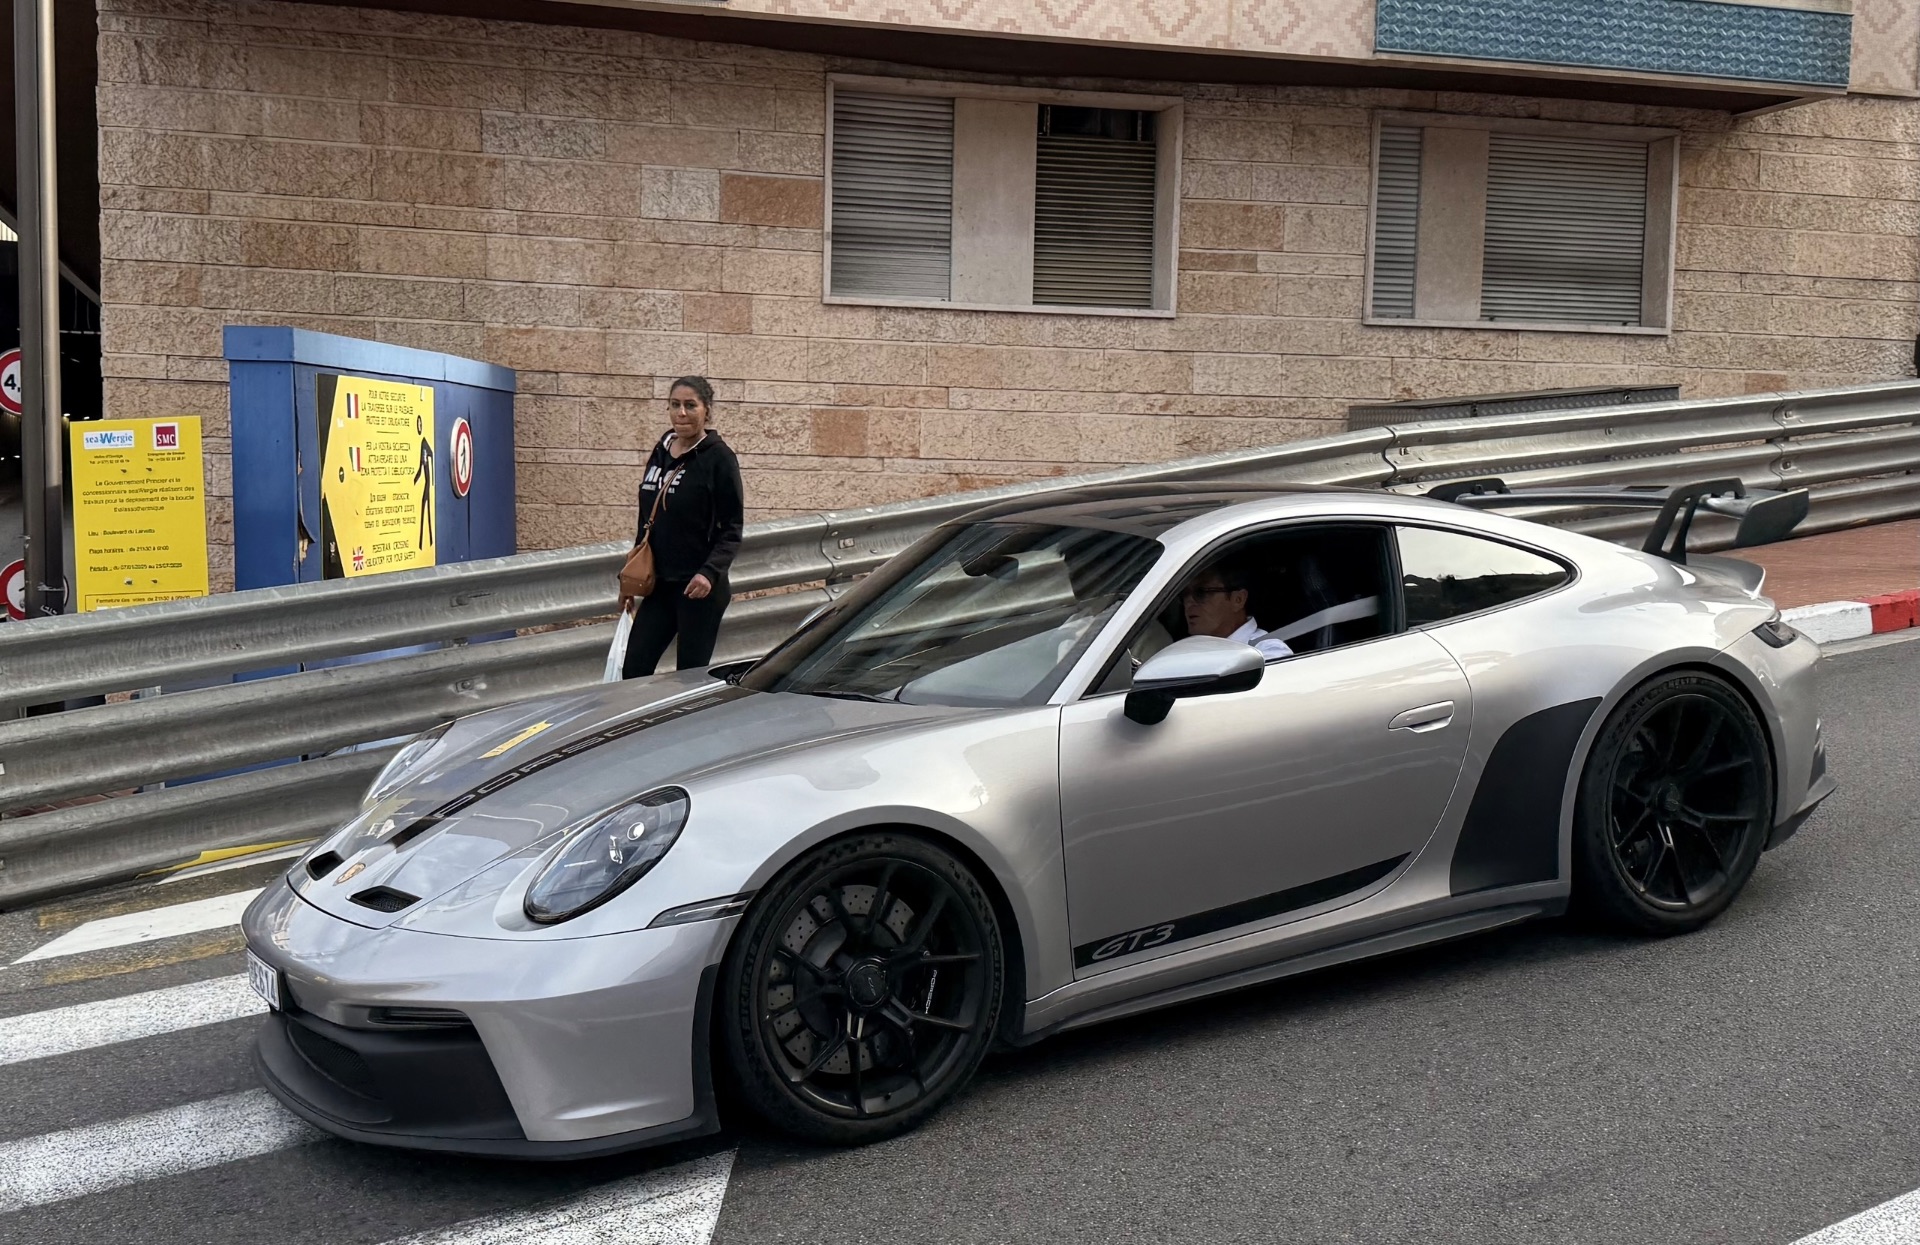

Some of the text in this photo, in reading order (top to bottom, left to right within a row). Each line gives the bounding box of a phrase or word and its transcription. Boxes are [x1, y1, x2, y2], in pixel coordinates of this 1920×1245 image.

[4, 374, 20, 392] 4,
[157, 434, 175, 444] SMC
[434, 696, 724, 819] PORSCHE
[1092, 924, 1175, 960] GT3
[925, 969, 938, 1014] PORSCH
